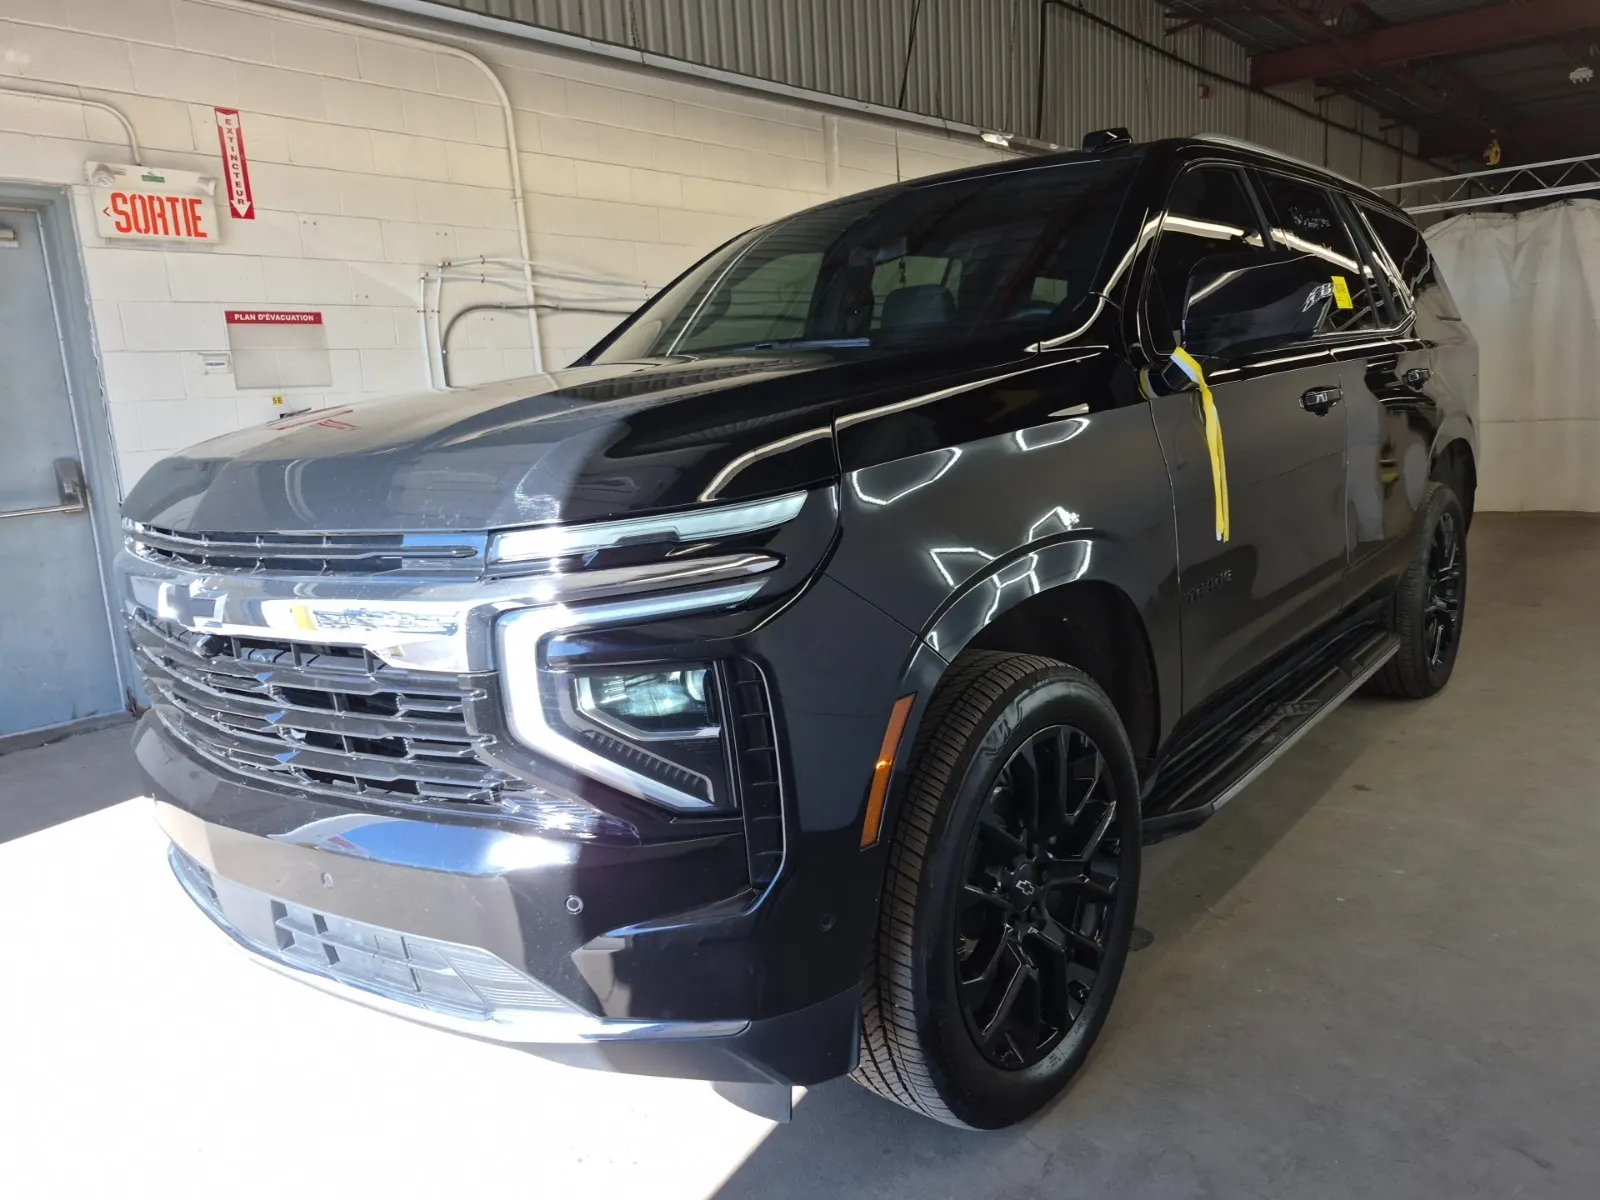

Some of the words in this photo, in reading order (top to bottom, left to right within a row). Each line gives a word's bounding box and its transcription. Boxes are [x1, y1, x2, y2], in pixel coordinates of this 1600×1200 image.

[225, 118, 245, 205] EXTINCTEUR
[110, 192, 208, 238] SORTIE
[234, 313, 256, 321] PLAN
[257, 312, 314, 321] D'ÉVACUATION
